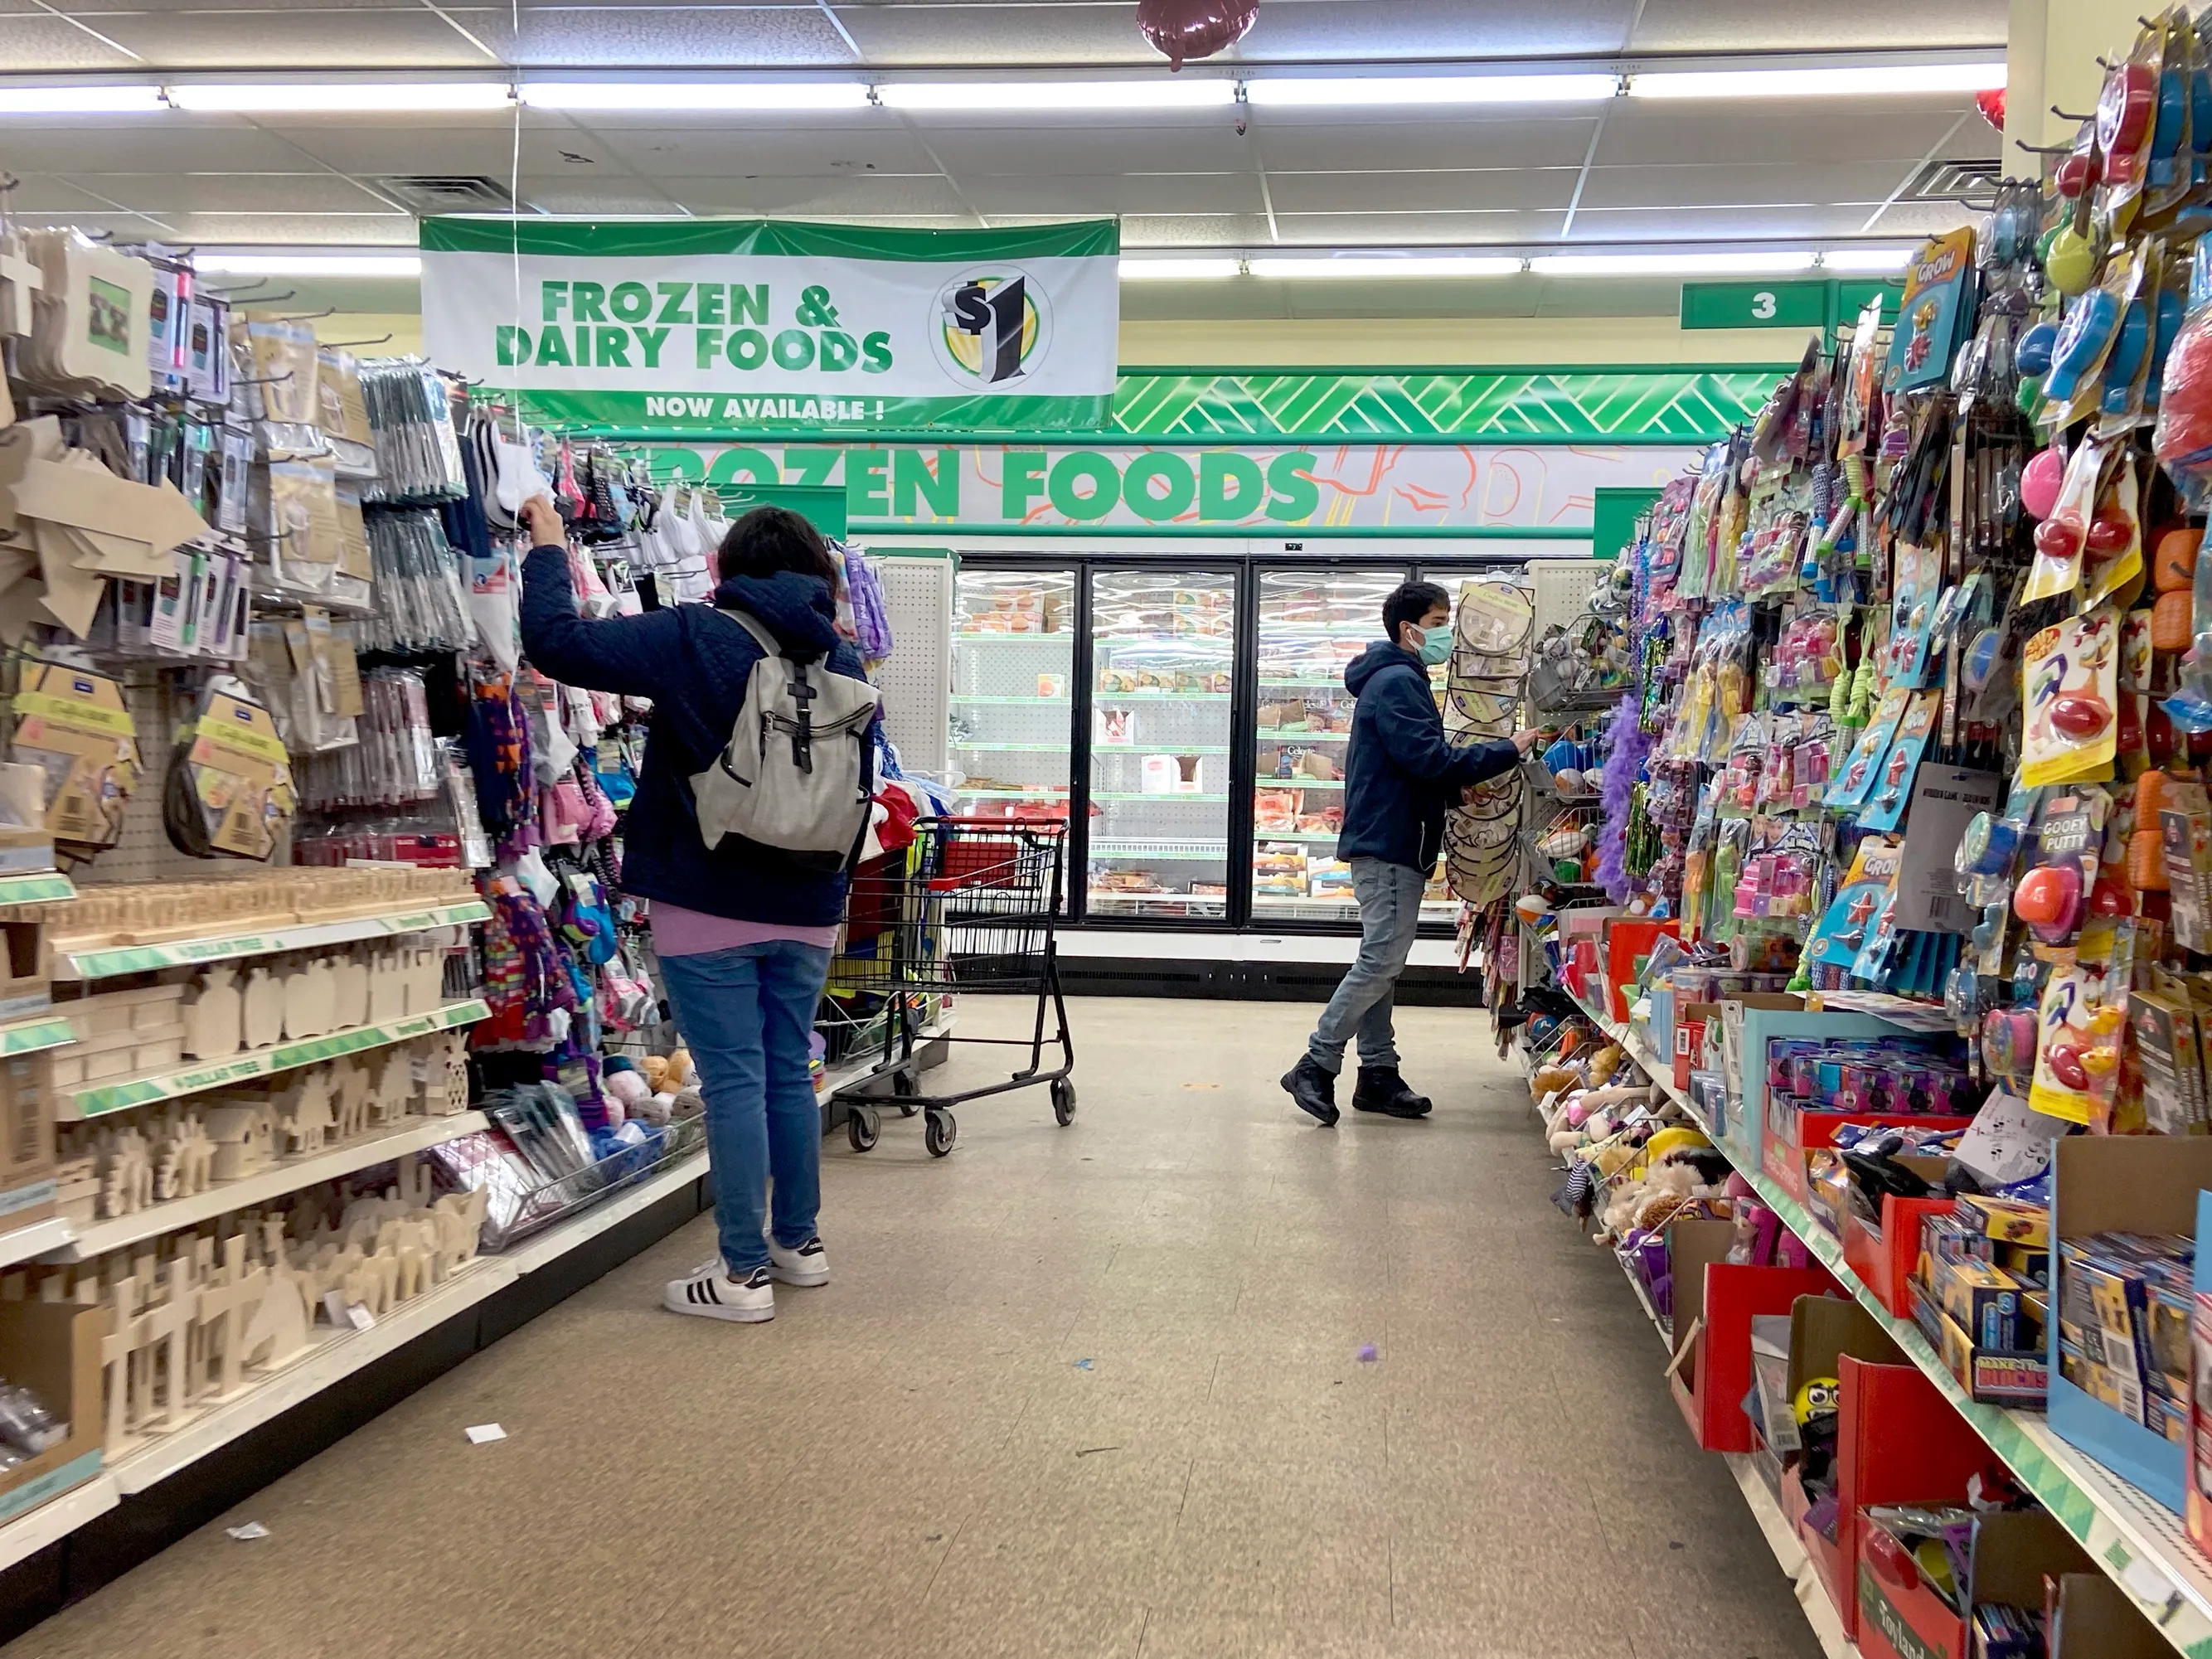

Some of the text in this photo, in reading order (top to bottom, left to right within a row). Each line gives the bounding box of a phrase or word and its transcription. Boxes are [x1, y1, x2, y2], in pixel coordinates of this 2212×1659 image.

[1917, 250, 1956, 284] GROW
[541, 280, 842, 328] FROZEN &
[1751, 292, 1777, 319] 3
[942, 275, 1027, 384] $1
[496, 324, 894, 374] DAIRY FOODS
[645, 396, 885, 421] NOW AVAILABLE !
[614, 447, 1319, 521] ROZEN FOODS
[2045, 832, 2087, 851] PUTTY
[1864, 856, 1898, 876] GRO
